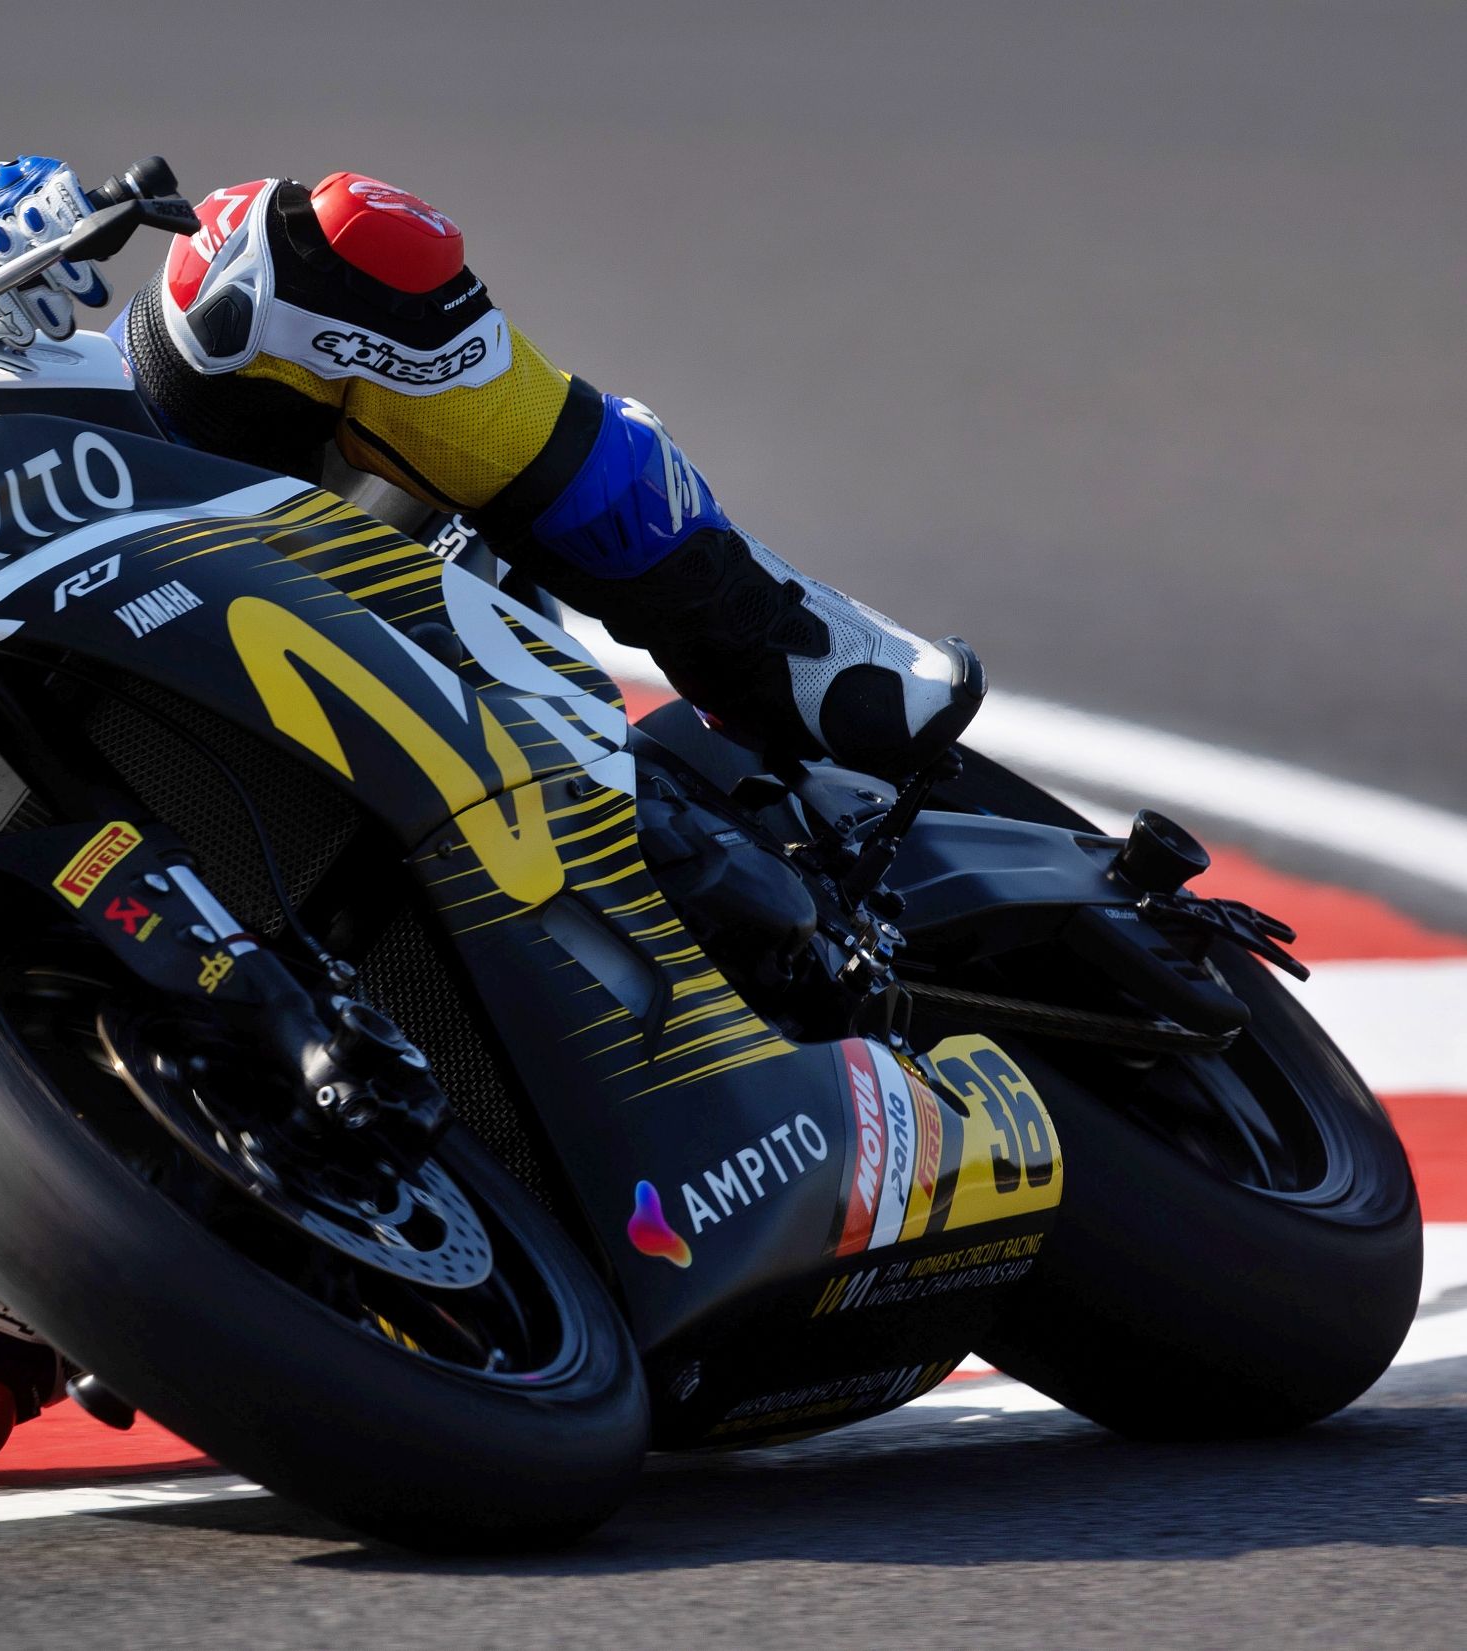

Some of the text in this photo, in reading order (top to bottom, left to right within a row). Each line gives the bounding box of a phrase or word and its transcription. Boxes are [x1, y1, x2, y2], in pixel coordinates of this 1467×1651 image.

[312, 330, 487, 385] alpinestars
[53, 554, 122, 612] R7
[113, 579, 204, 639] YAMAHA
[59, 825, 138, 897] PIRELLI
[197, 951, 235, 995] sbs
[850, 1062, 882, 1215] MOTUL
[936, 1049, 1054, 1195] 36
[680, 1113, 829, 1234] AMPITO
[865, 1259, 1033, 1306] WORLD CHAMPIONSHIP
[882, 1233, 1044, 1282] FIM WOMEN'S CIRCUIT RACING
